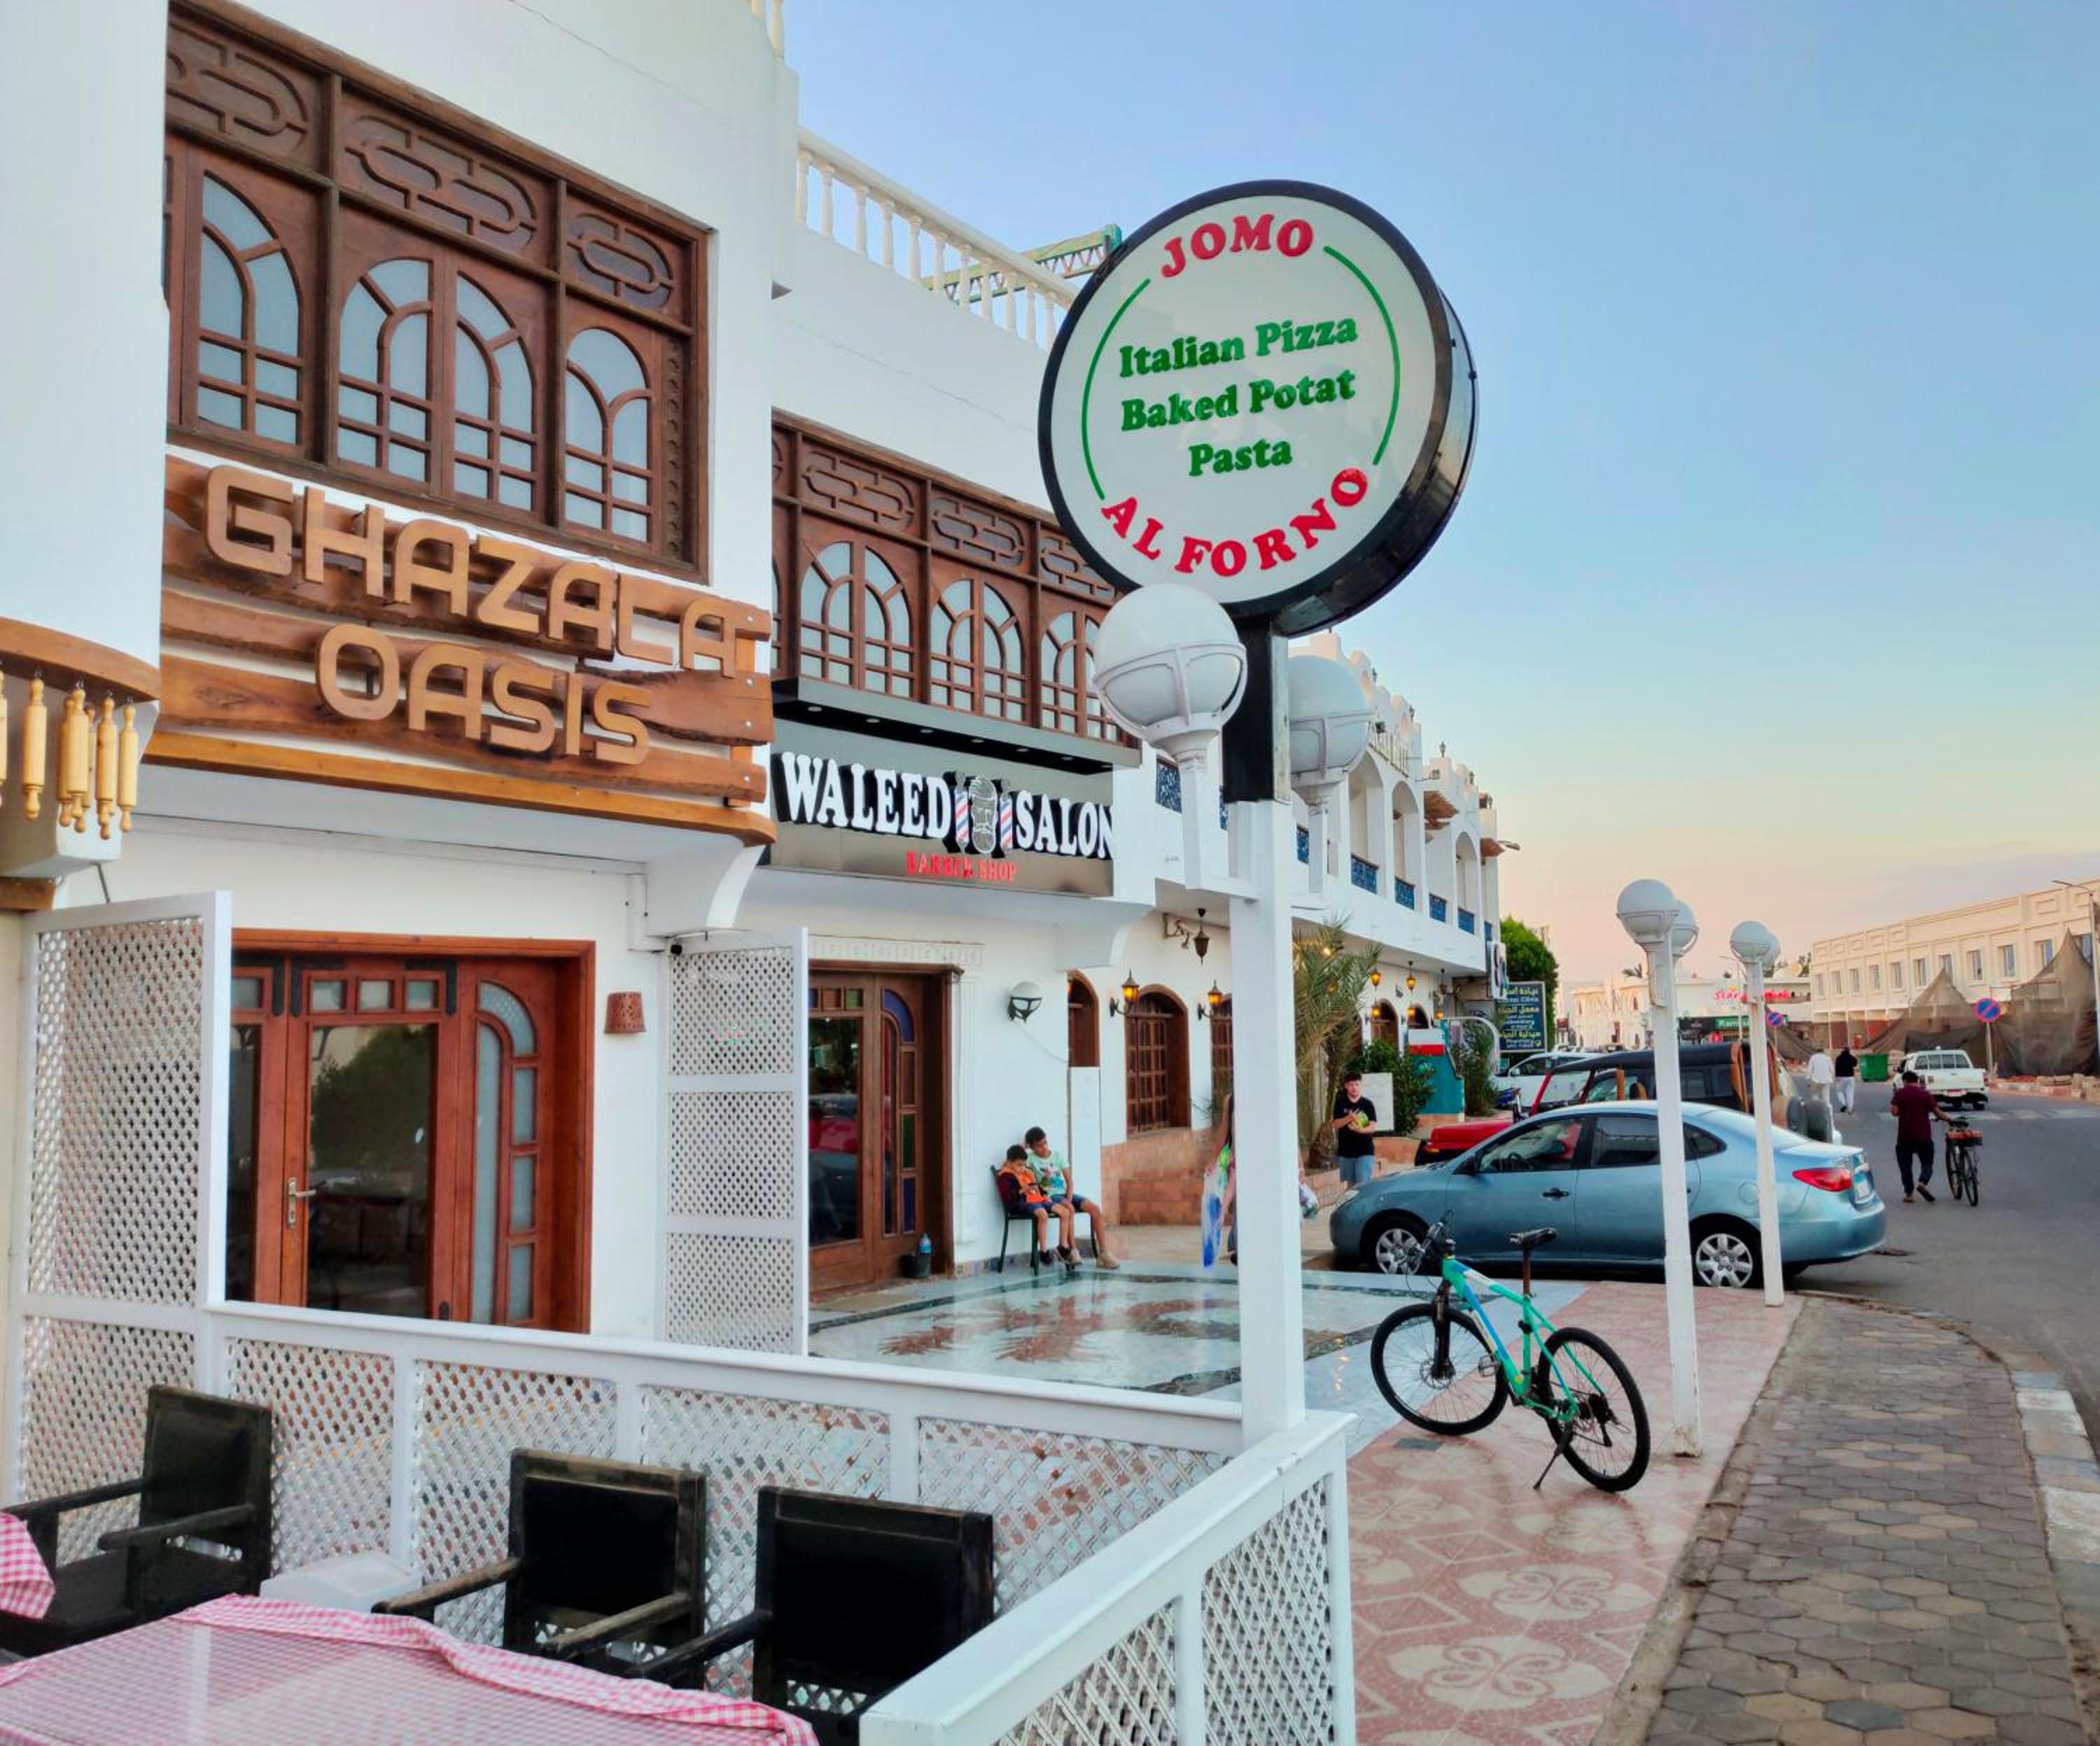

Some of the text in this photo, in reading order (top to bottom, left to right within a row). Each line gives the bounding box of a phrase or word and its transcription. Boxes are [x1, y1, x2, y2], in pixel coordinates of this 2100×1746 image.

[1162, 214, 1313, 279] JOMO
[1119, 318, 1357, 378] Italian Pizza
[1121, 369, 1356, 431] Baked Potat
[1188, 439, 1293, 477] Pasta
[1101, 469, 1368, 577] AL FORNO
[206, 465, 736, 679] GHAZALA
[315, 623, 650, 766] OASIS
[780, 751, 1114, 860] WALEED SALON
[978, 858, 1017, 884] SHOP
